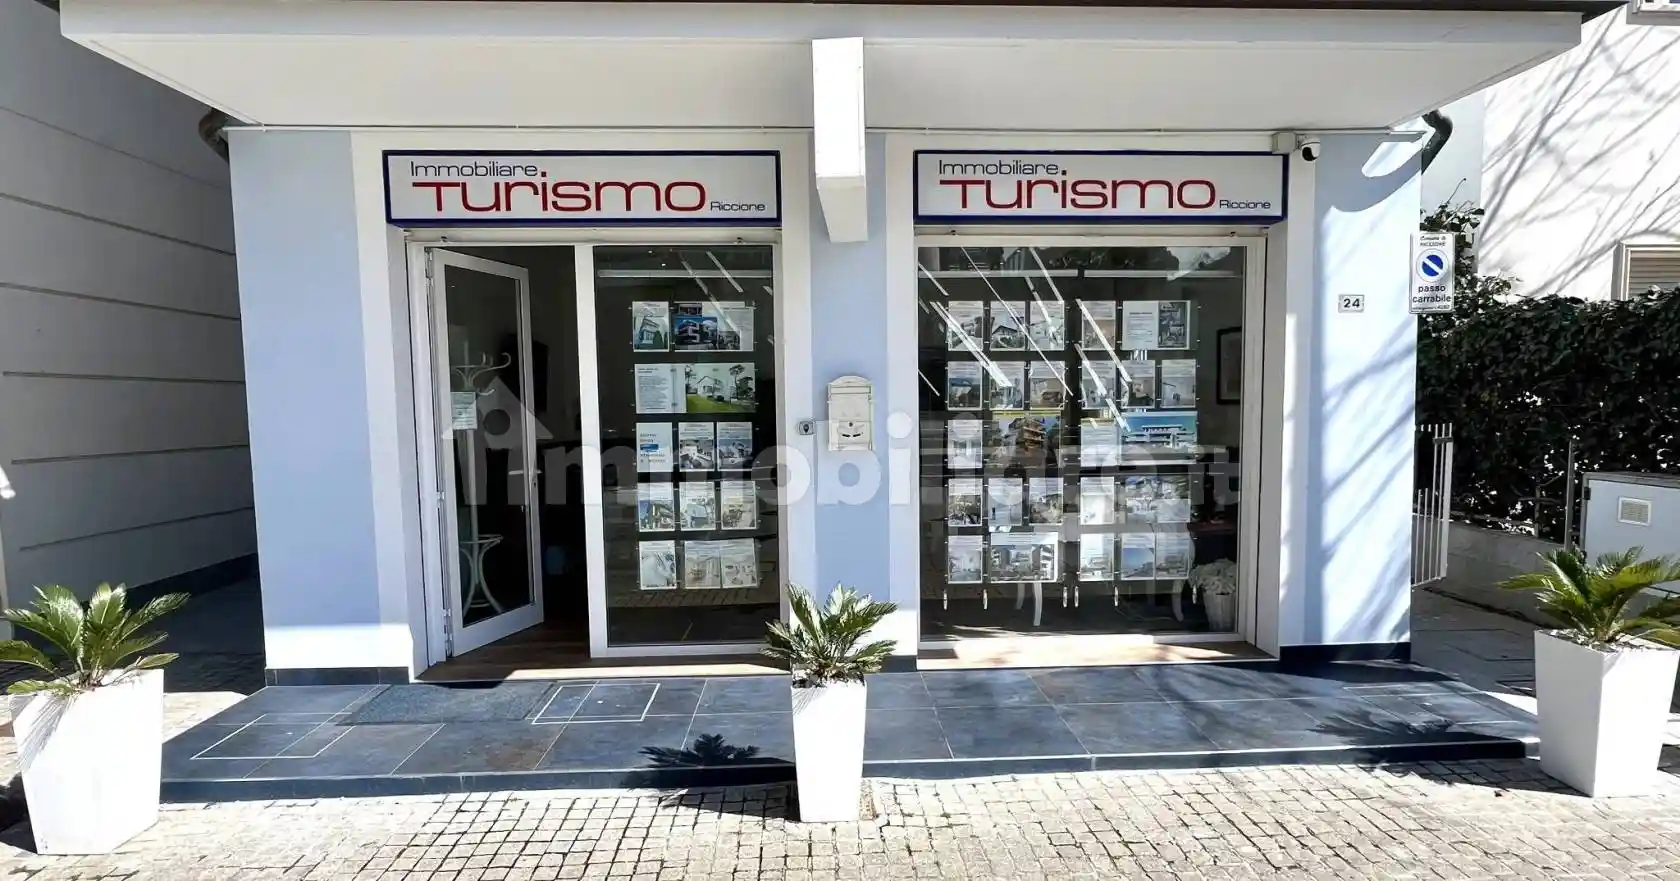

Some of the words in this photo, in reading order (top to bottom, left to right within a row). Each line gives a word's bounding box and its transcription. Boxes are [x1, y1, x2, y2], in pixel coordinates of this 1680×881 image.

[410, 160, 538, 177] Immobiliare
[938, 159, 1059, 176] Immobiliare
[411, 171, 707, 212] Turismo
[710, 200, 766, 212] Riccione
[939, 169, 1217, 209] Turismo
[1219, 199, 1272, 209] Riccione
[1418, 285, 1446, 293] passo
[1343, 298, 1360, 308] 24
[1412, 294, 1452, 303] carrabile
